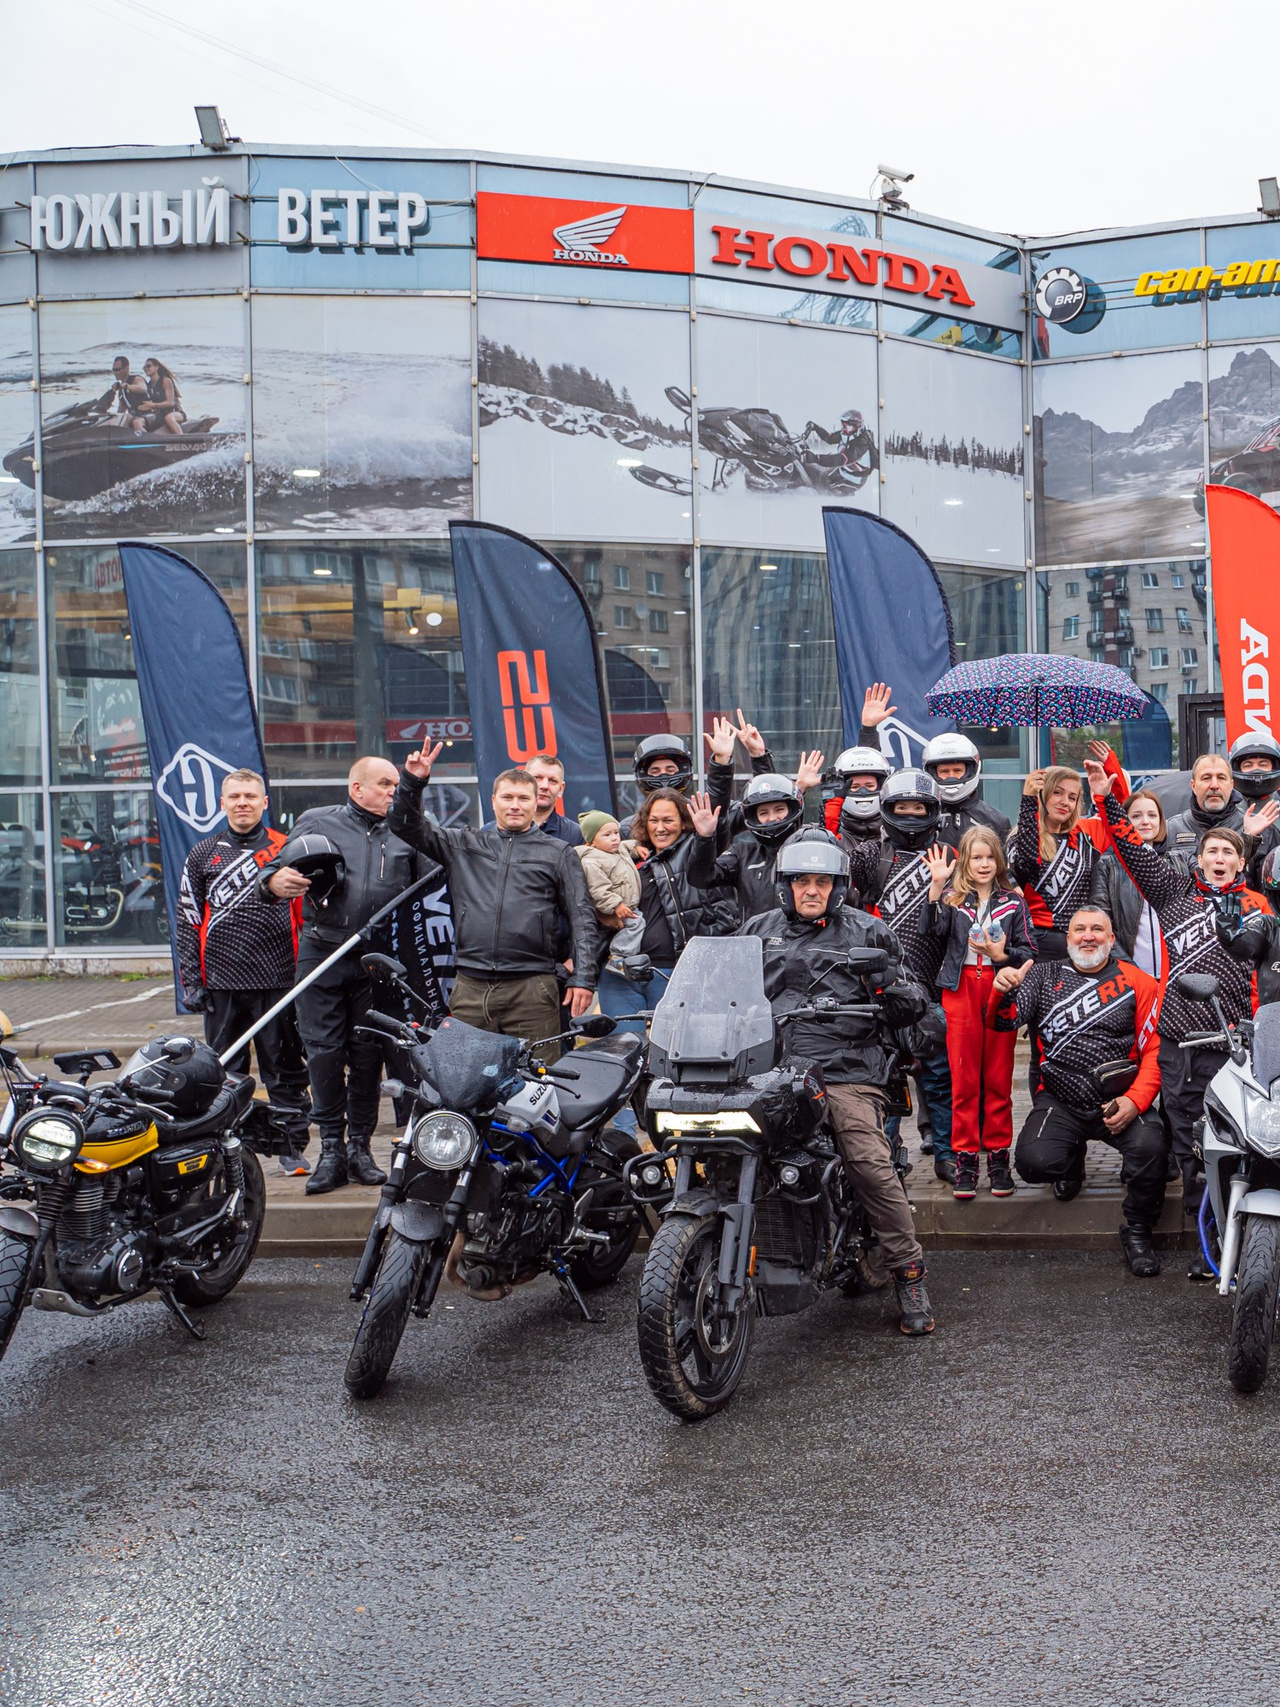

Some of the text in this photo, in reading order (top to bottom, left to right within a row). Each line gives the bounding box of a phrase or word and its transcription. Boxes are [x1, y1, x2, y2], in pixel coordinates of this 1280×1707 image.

[31, 177, 429, 251] ЮЖНЫЙ ВЕТЕР
[553, 249, 629, 265] HONDA
[711, 224, 975, 307] HONDA
[1055, 292, 1083, 306] BRP
[425, 721, 472, 737] HO
